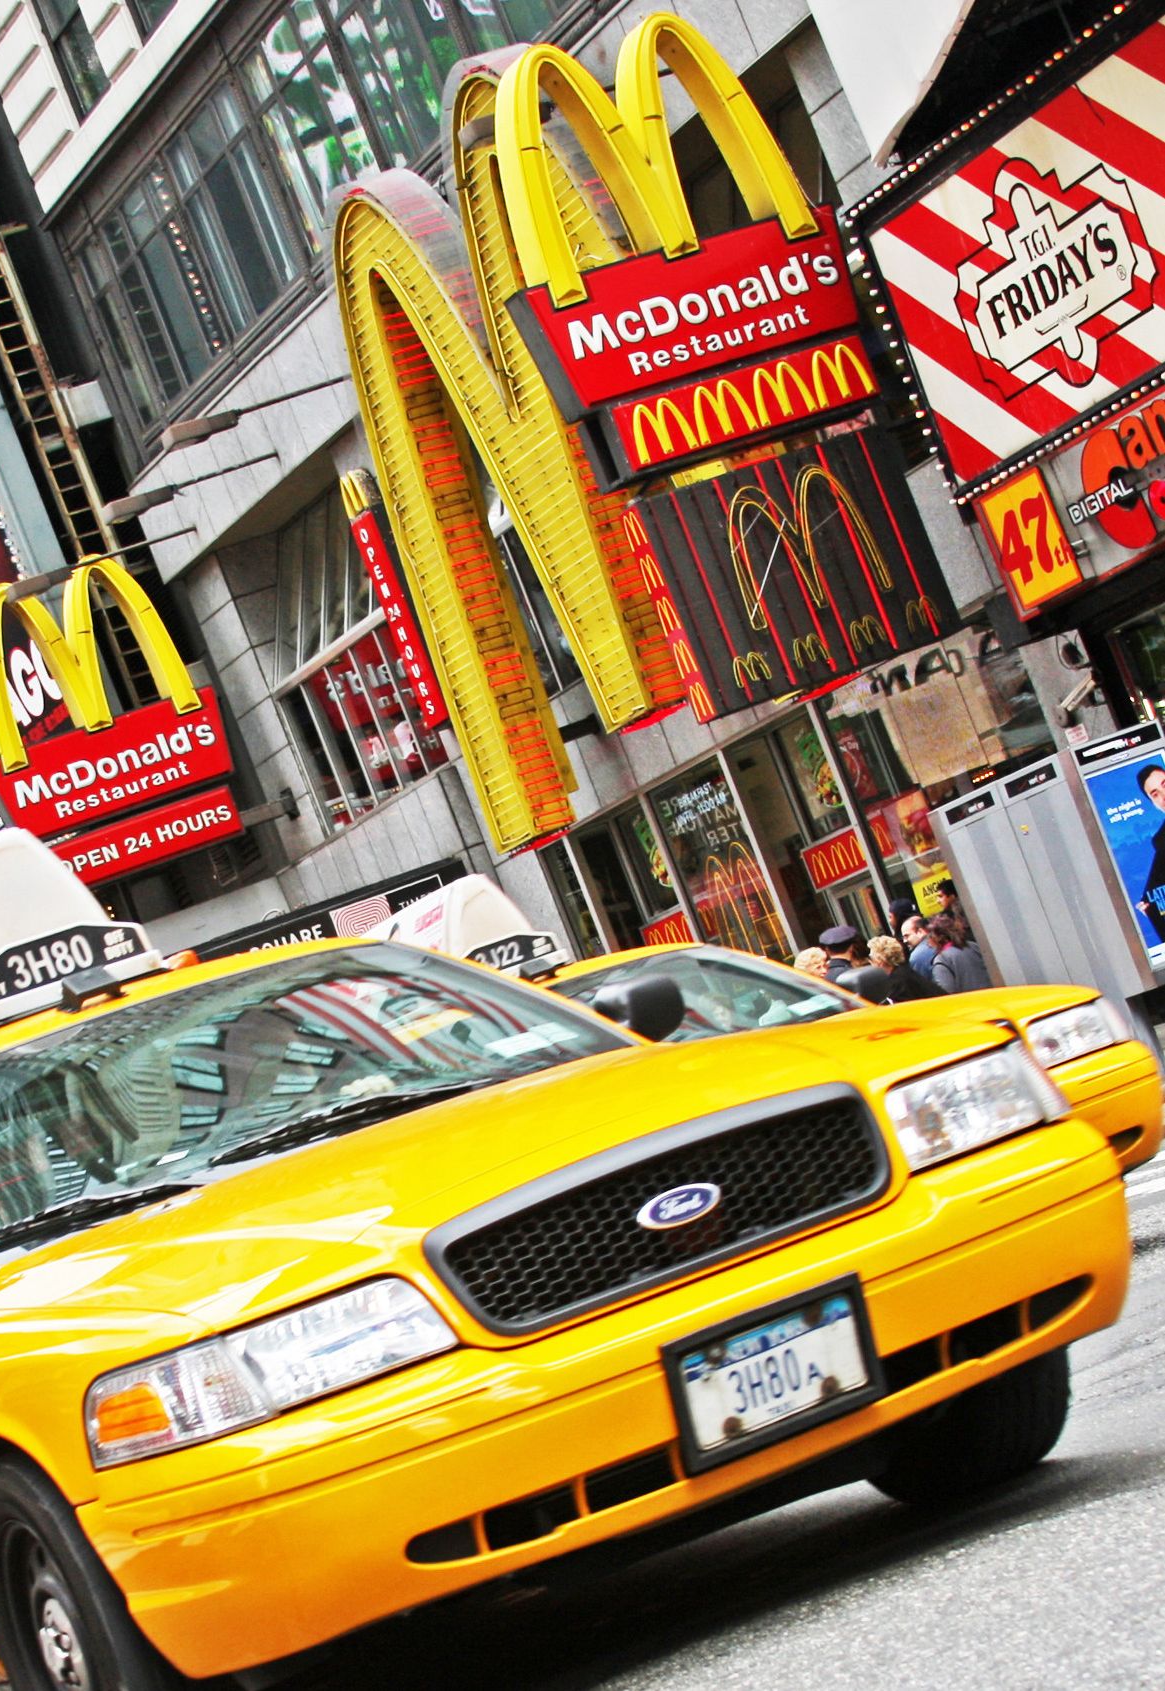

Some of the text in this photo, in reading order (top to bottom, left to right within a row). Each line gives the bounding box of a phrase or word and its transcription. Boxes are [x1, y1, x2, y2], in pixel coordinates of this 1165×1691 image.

[565, 249, 839, 360] McDonald's
[985, 222, 1118, 340] FRIDAY'S
[628, 303, 811, 375] Restaurant
[1068, 478, 1134, 525] DIGITAL
[359, 527, 437, 715] OPEN 24 HOURS
[15, 723, 217, 809] McDonald's
[55, 761, 191, 819] Restaurant
[123, 834, 153, 856] 24
[157, 804, 233, 842] HOURS
[6, 933, 95, 991] 3H80
[658, 1192, 704, 1219] Ford
[727, 1348, 802, 1414] 3H80
